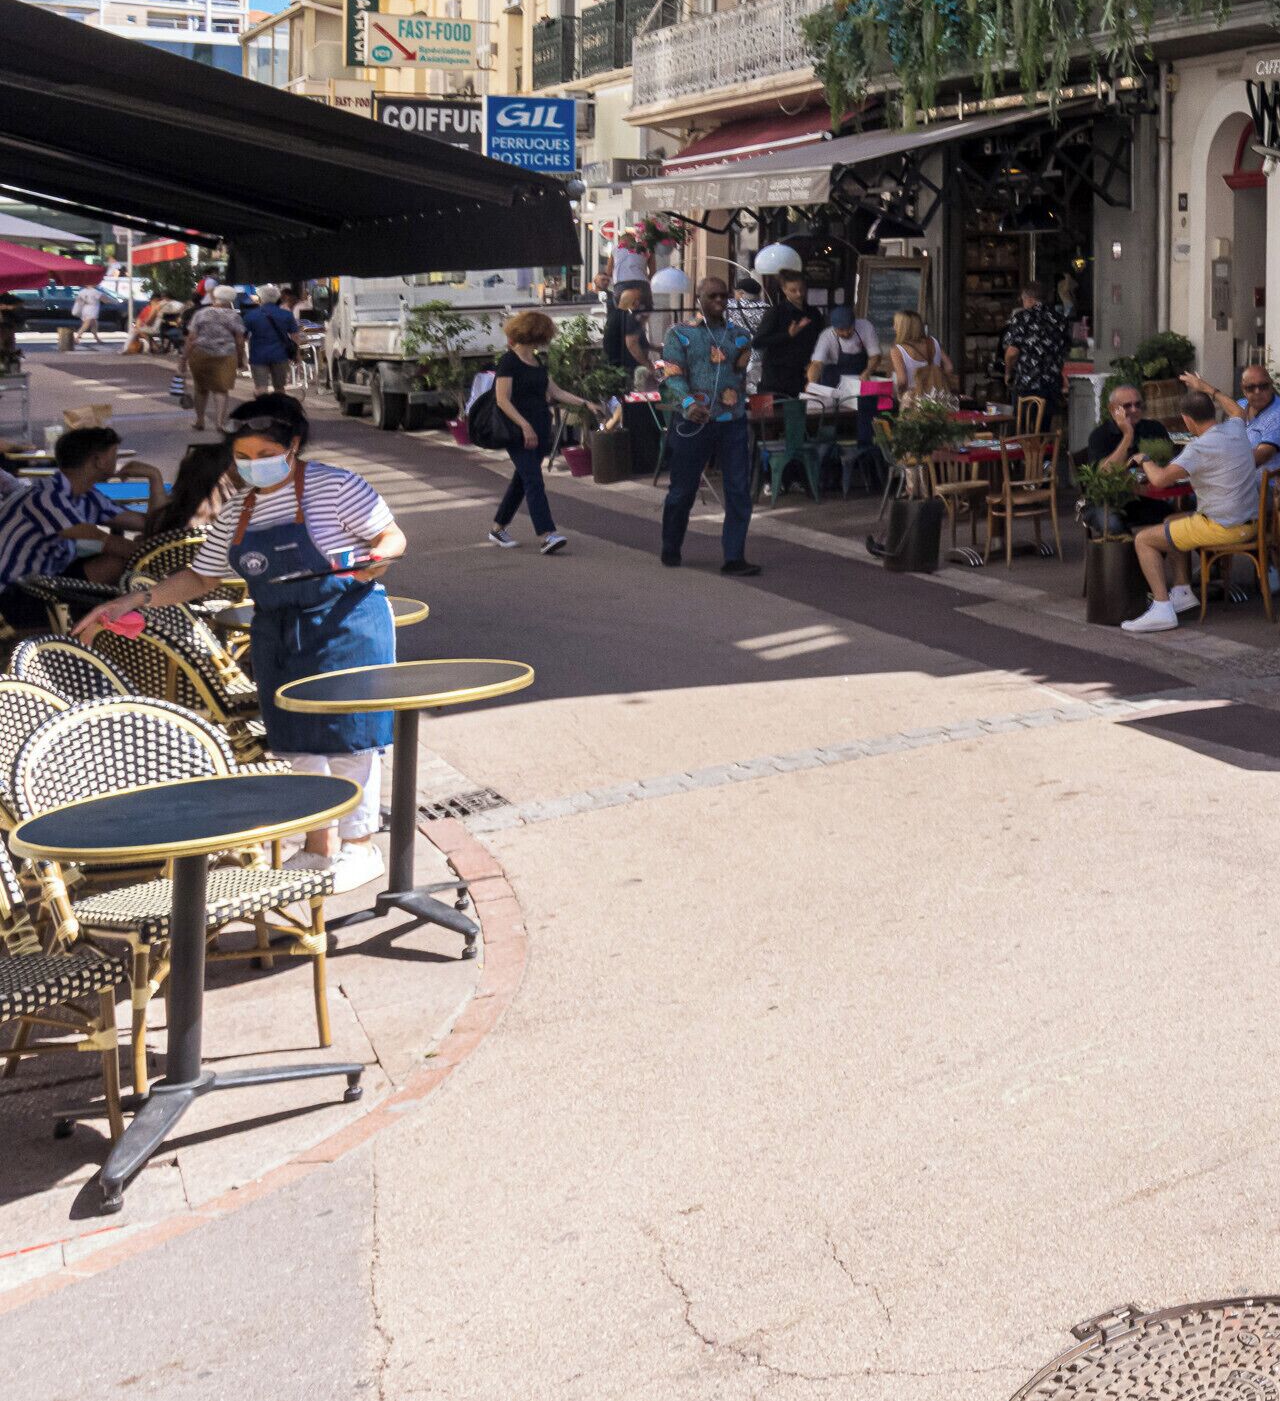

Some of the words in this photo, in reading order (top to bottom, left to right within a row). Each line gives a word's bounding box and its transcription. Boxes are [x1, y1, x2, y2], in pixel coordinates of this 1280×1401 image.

[398, 19, 471, 42] FAST-FOOD
[382, 104, 483, 133] COIFFUR
[496, 103, 565, 128] GIL
[491, 136, 570, 150] PERRUQUES
[491, 153, 570, 167] POSTICHES
